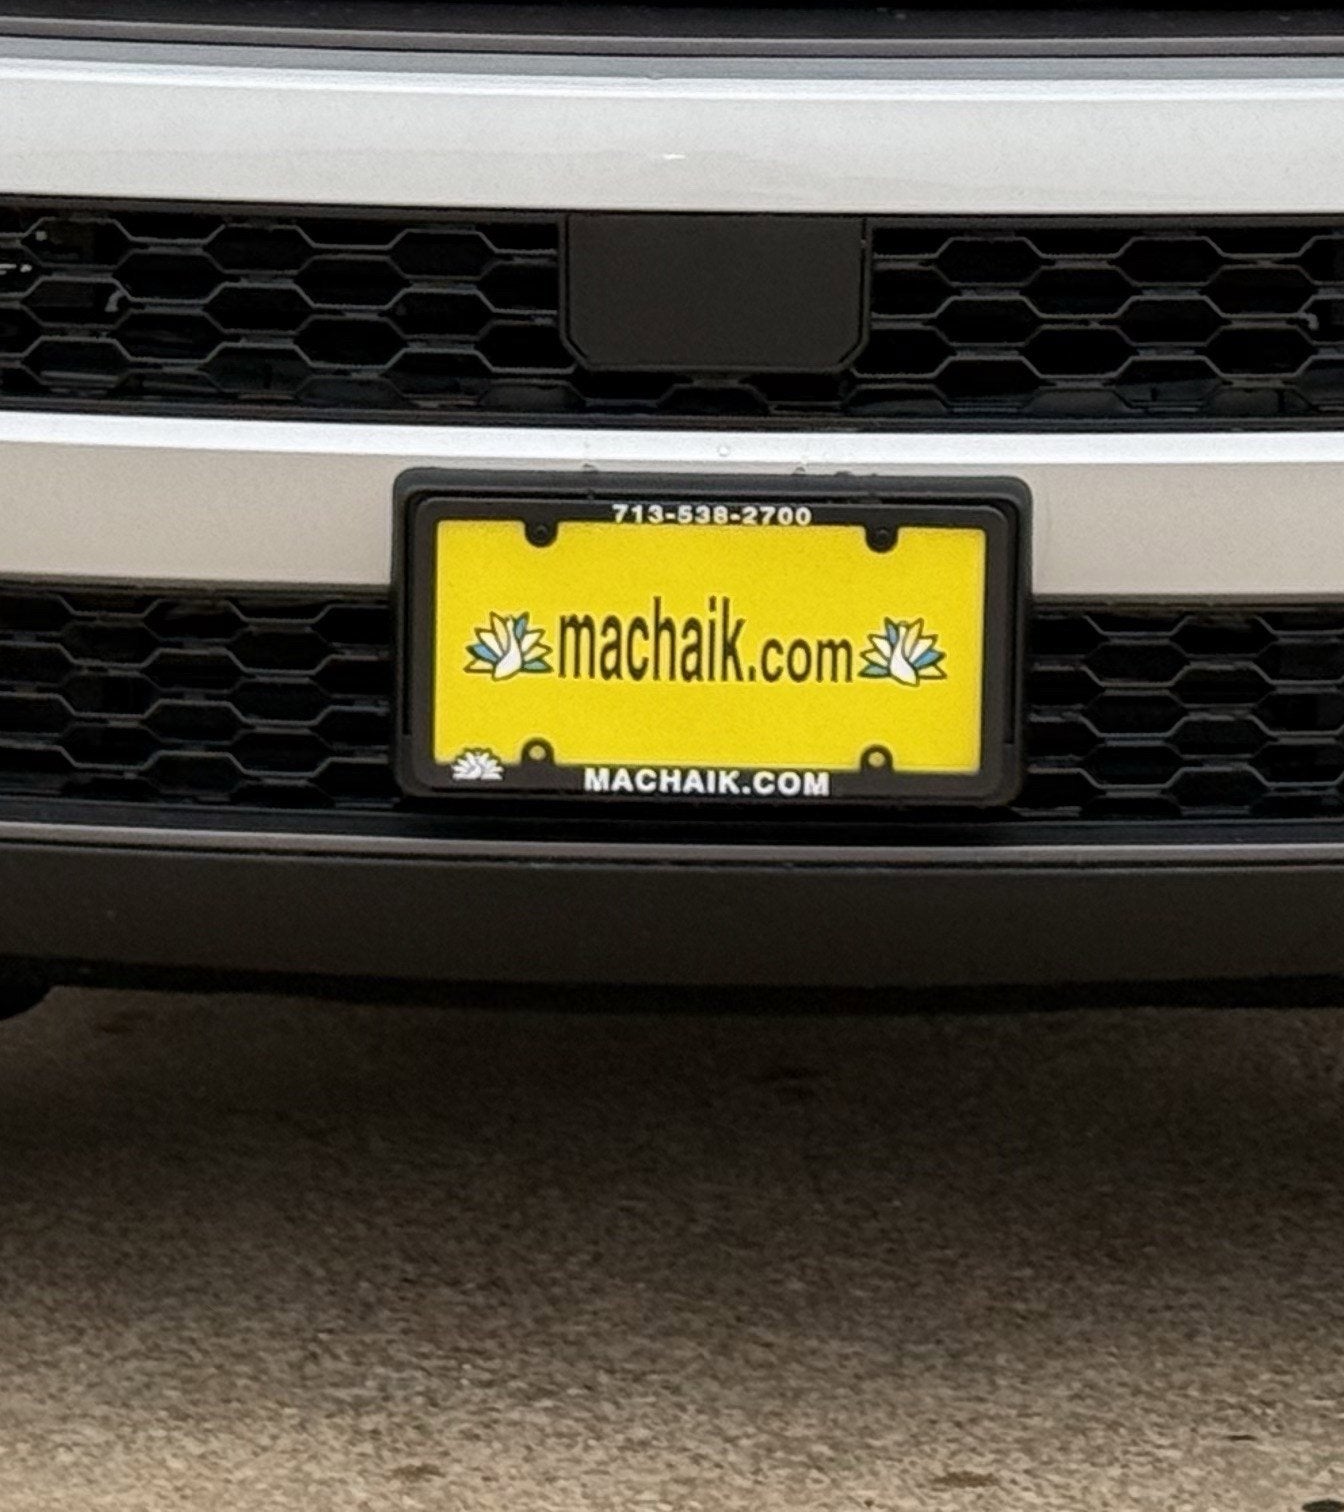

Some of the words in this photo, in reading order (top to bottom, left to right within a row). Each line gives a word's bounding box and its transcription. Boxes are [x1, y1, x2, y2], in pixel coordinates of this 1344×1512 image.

[612, 504, 812, 526] 713-538-2700
[557, 596, 854, 683] machaik.com
[583, 767, 830, 797] MACHAIK.COM
